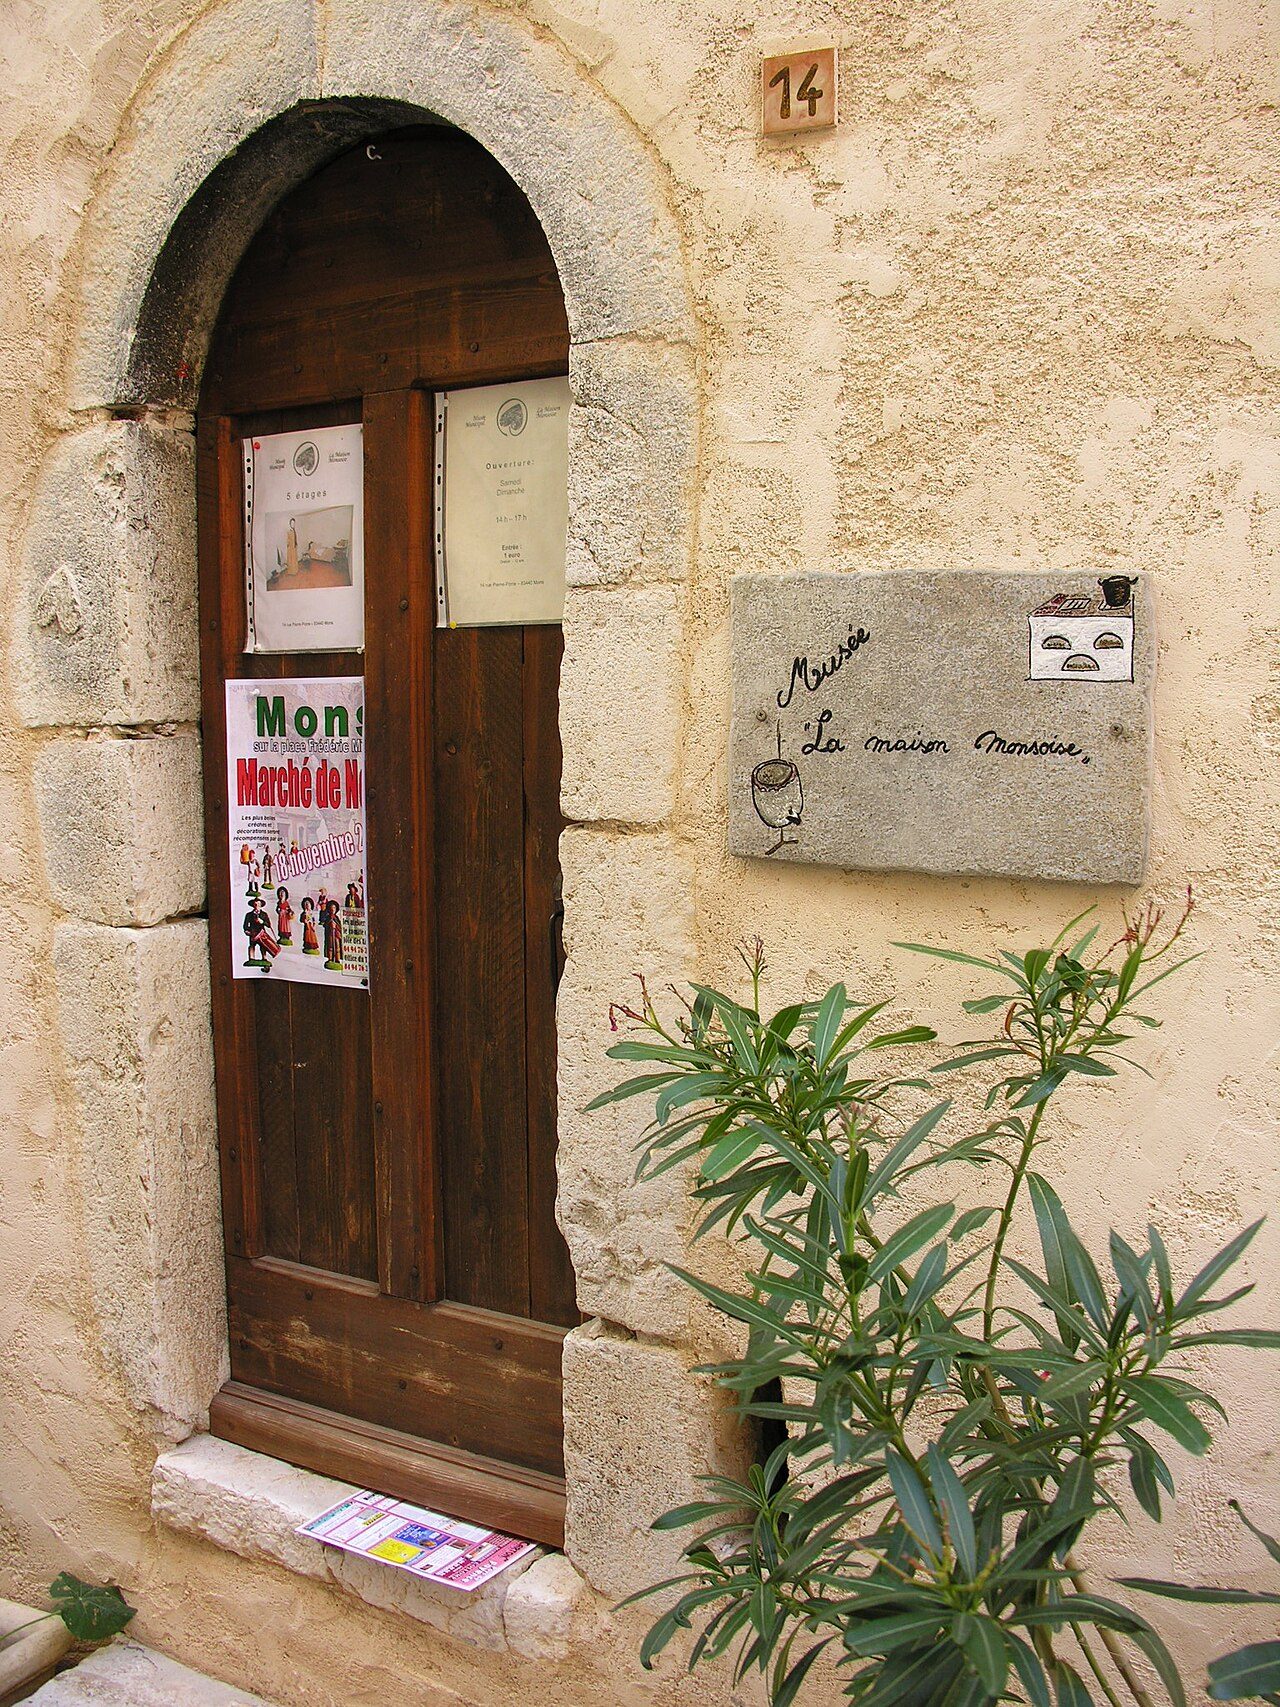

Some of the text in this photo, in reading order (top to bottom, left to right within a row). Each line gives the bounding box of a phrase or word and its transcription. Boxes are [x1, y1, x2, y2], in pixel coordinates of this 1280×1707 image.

[769, 63, 823, 119] 14
[496, 487, 525, 496] Dimanche
[500, 479, 521, 487] Samedi
[286, 490, 327, 500] 5 étages
[777, 624, 870, 708] Musée
[254, 741, 268, 752] sur
[270, 739, 279, 752] la
[281, 739, 306, 755] place
[308, 738, 349, 753] Frédéric
[864, 733, 950, 754] maison
[237, 757, 312, 808] Marché
[316, 759, 341, 809] de
[273, 852, 289, 882] 18
[288, 831, 355, 877] novembre
